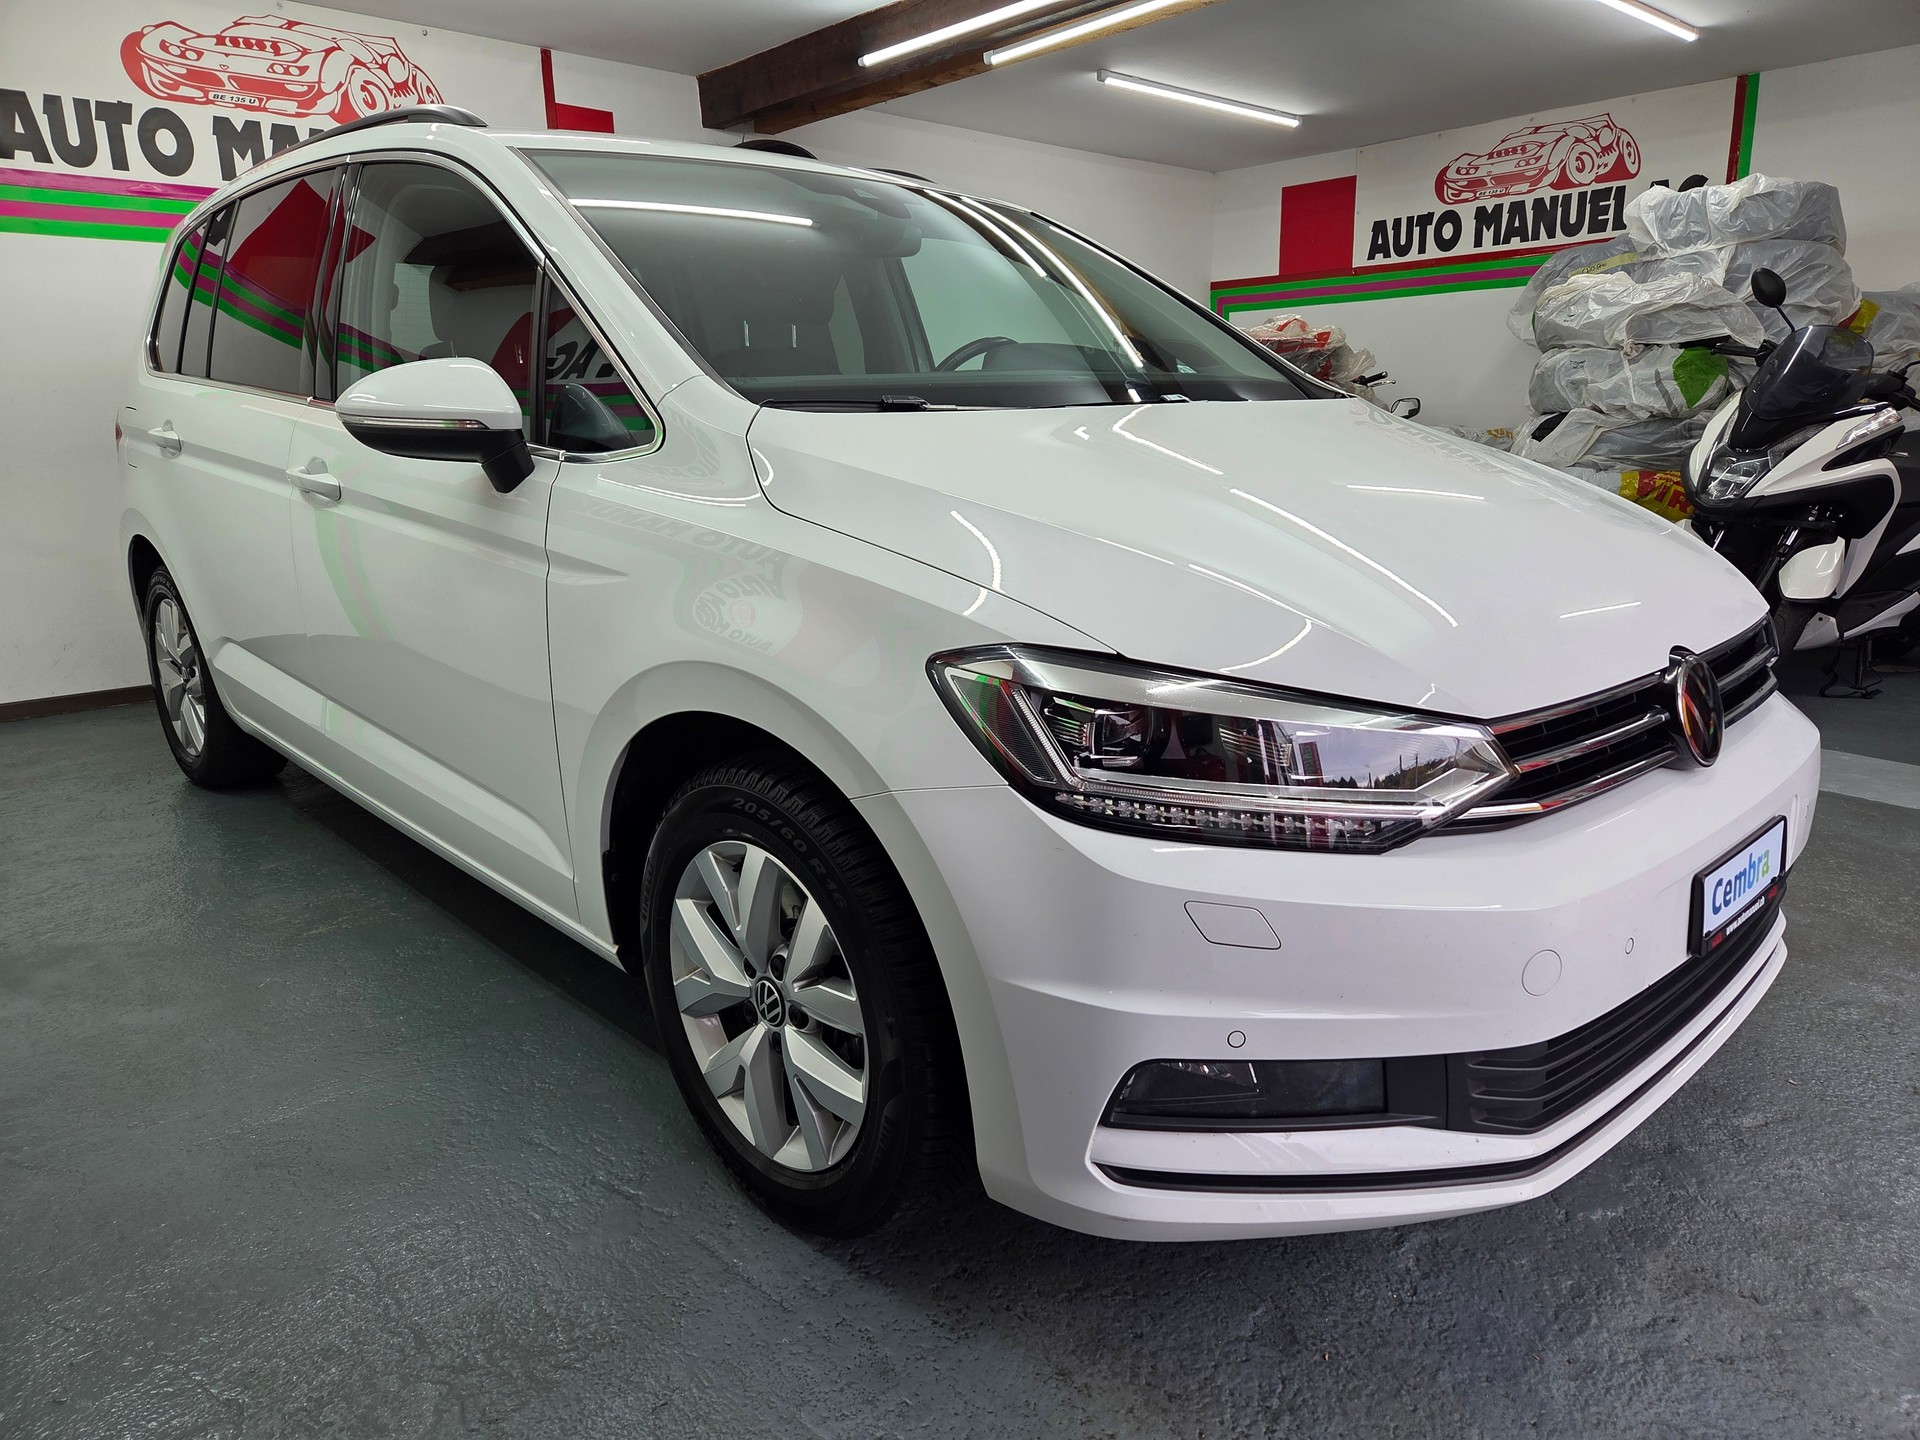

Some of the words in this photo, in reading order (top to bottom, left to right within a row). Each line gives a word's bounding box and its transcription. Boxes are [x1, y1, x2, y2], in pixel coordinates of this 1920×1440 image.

[212, 93, 227, 101] BE
[229, 95, 246, 103] 135
[0, 87, 194, 177] AUTO
[1367, 209, 1462, 260] AUTO
[1711, 848, 1770, 916] Cembra
